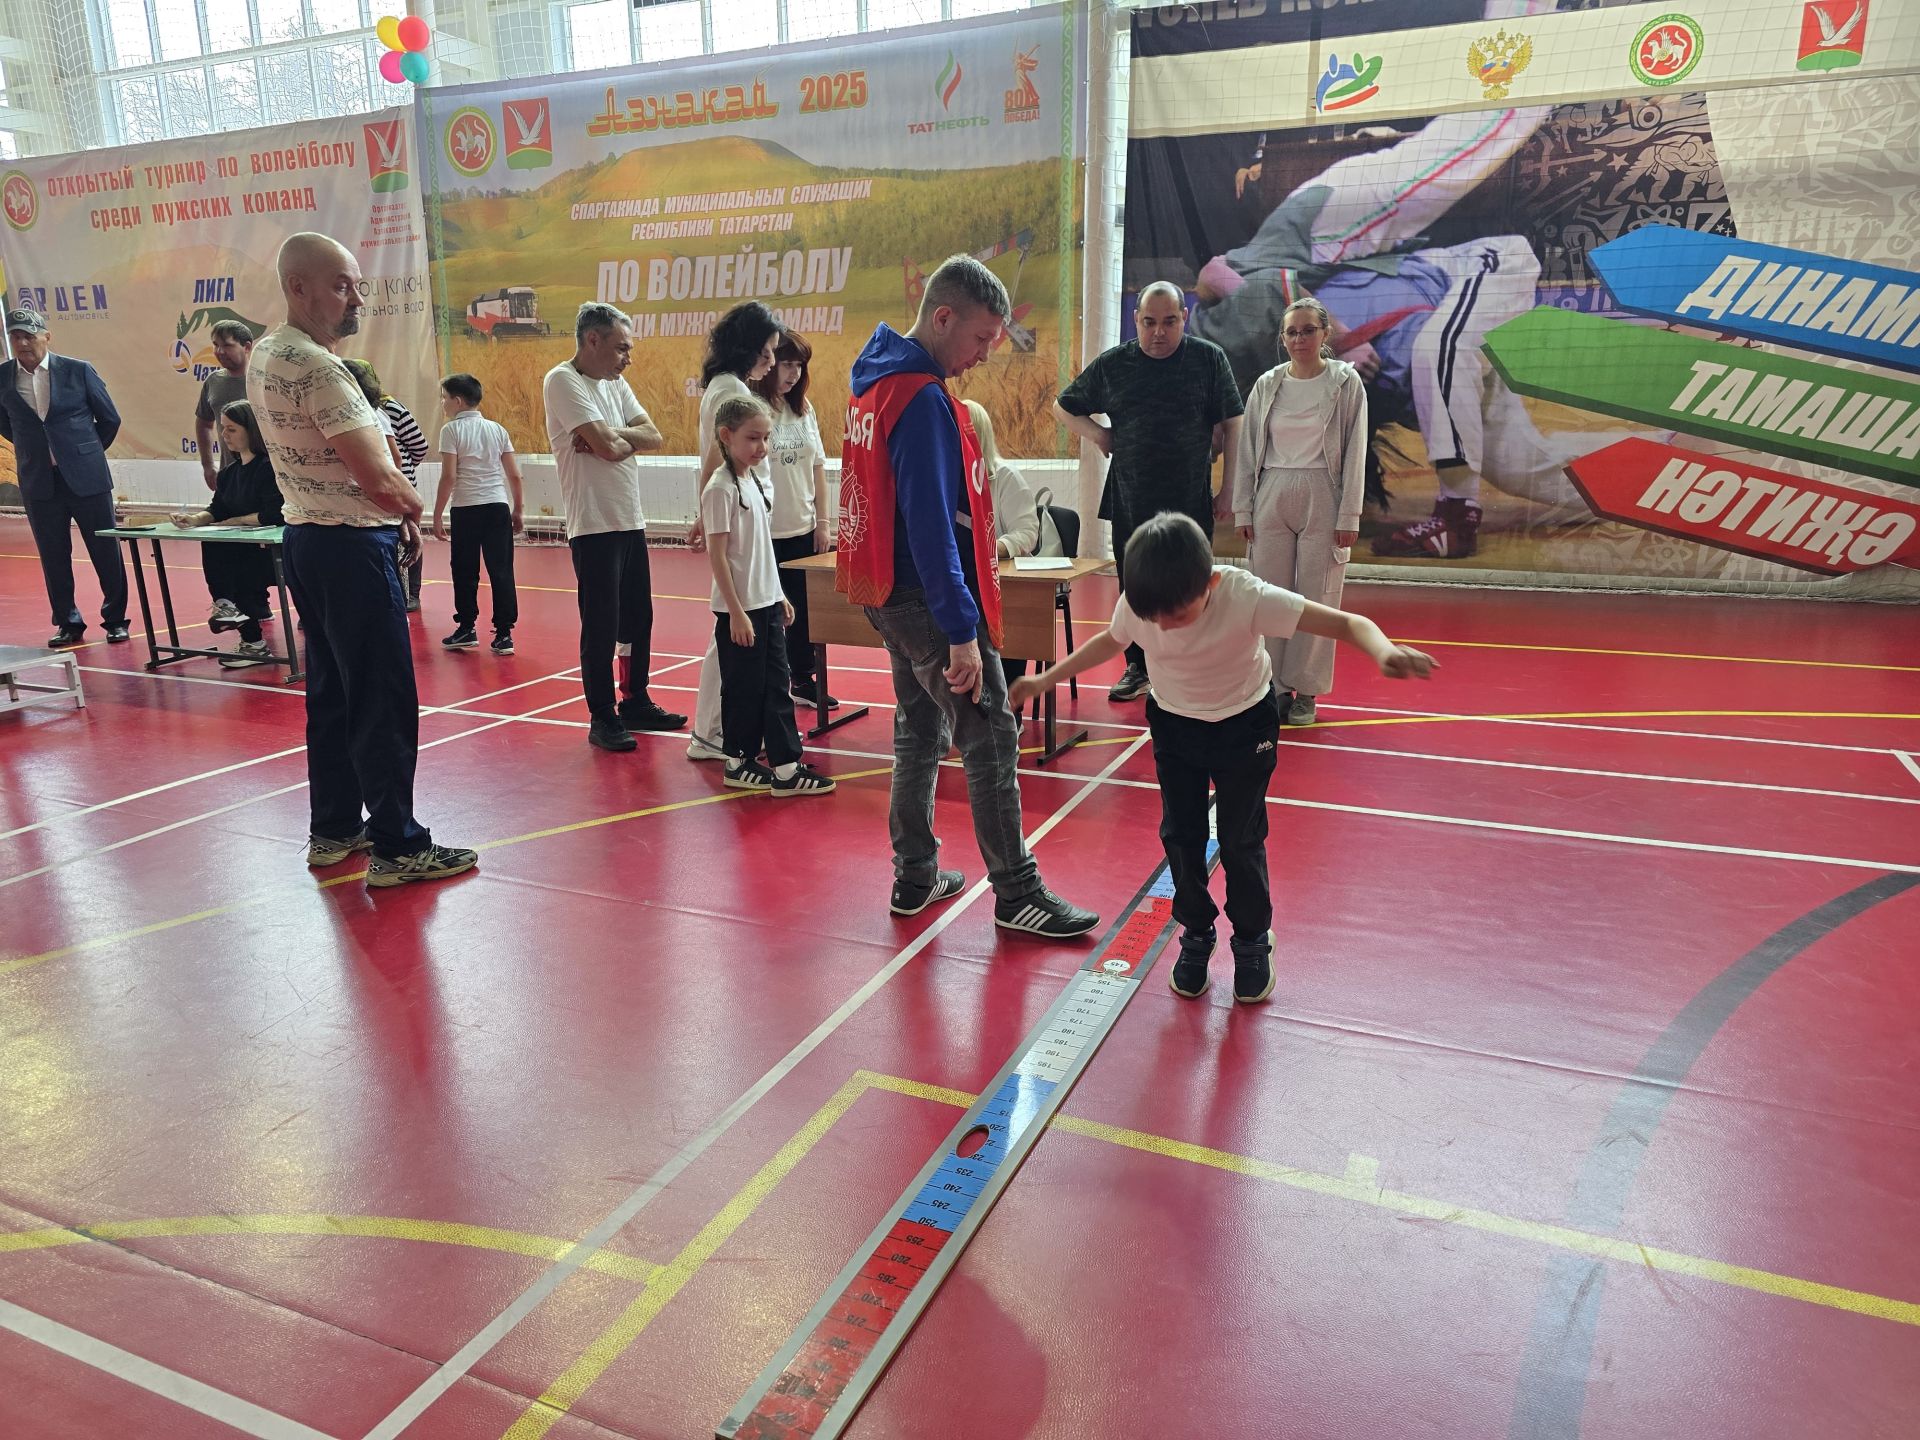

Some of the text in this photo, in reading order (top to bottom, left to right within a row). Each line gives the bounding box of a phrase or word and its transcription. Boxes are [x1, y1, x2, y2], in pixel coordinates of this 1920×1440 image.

[799, 70, 869, 115] 2025
[1004, 109, 1041, 125] ПОБЕДА!
[907, 115, 991, 135] ТАТНЕФТЬ
[144, 159, 207, 190] турнир
[217, 155, 239, 179] по
[250, 140, 355, 175] волейболу
[570, 179, 873, 221] СПАРТАКИАДА МУНИЦИПАЛЬНЫХ СЛУЖАЩИХ
[90, 186, 318, 233] среди мужских команд
[631, 212, 794, 241] РЕСПУБЛИКИ ТАТАРСТАН
[596, 244, 853, 303] ПО ВОЛЕЙБОЛУ
[193, 277, 235, 304] ЛИГА
[360, 277, 380, 297] ой
[58, 311, 110, 321] AUTOMOBILE
[360, 303, 399, 317] альная
[1668, 360, 1920, 460] ТАМАША
[1636, 457, 1916, 566] НӘТИҖӘ
[1076, 1007, 1090, 1015] 170
[1054, 1038, 1069, 1046] 185
[1045, 1049, 1060, 1057] 190
[1037, 1061, 1052, 1069] 195
[989, 1123, 1006, 1132] 220
[955, 1167, 974, 1177] 235
[943, 1183, 962, 1193] 240
[931, 1199, 951, 1210] 245
[918, 1216, 938, 1228] 250
[906, 1234, 925, 1246] 255
[891, 1253, 911, 1265] 260
[878, 1272, 897, 1285] 265
[861, 1293, 882, 1306] 270
[846, 1314, 868, 1328] 275
